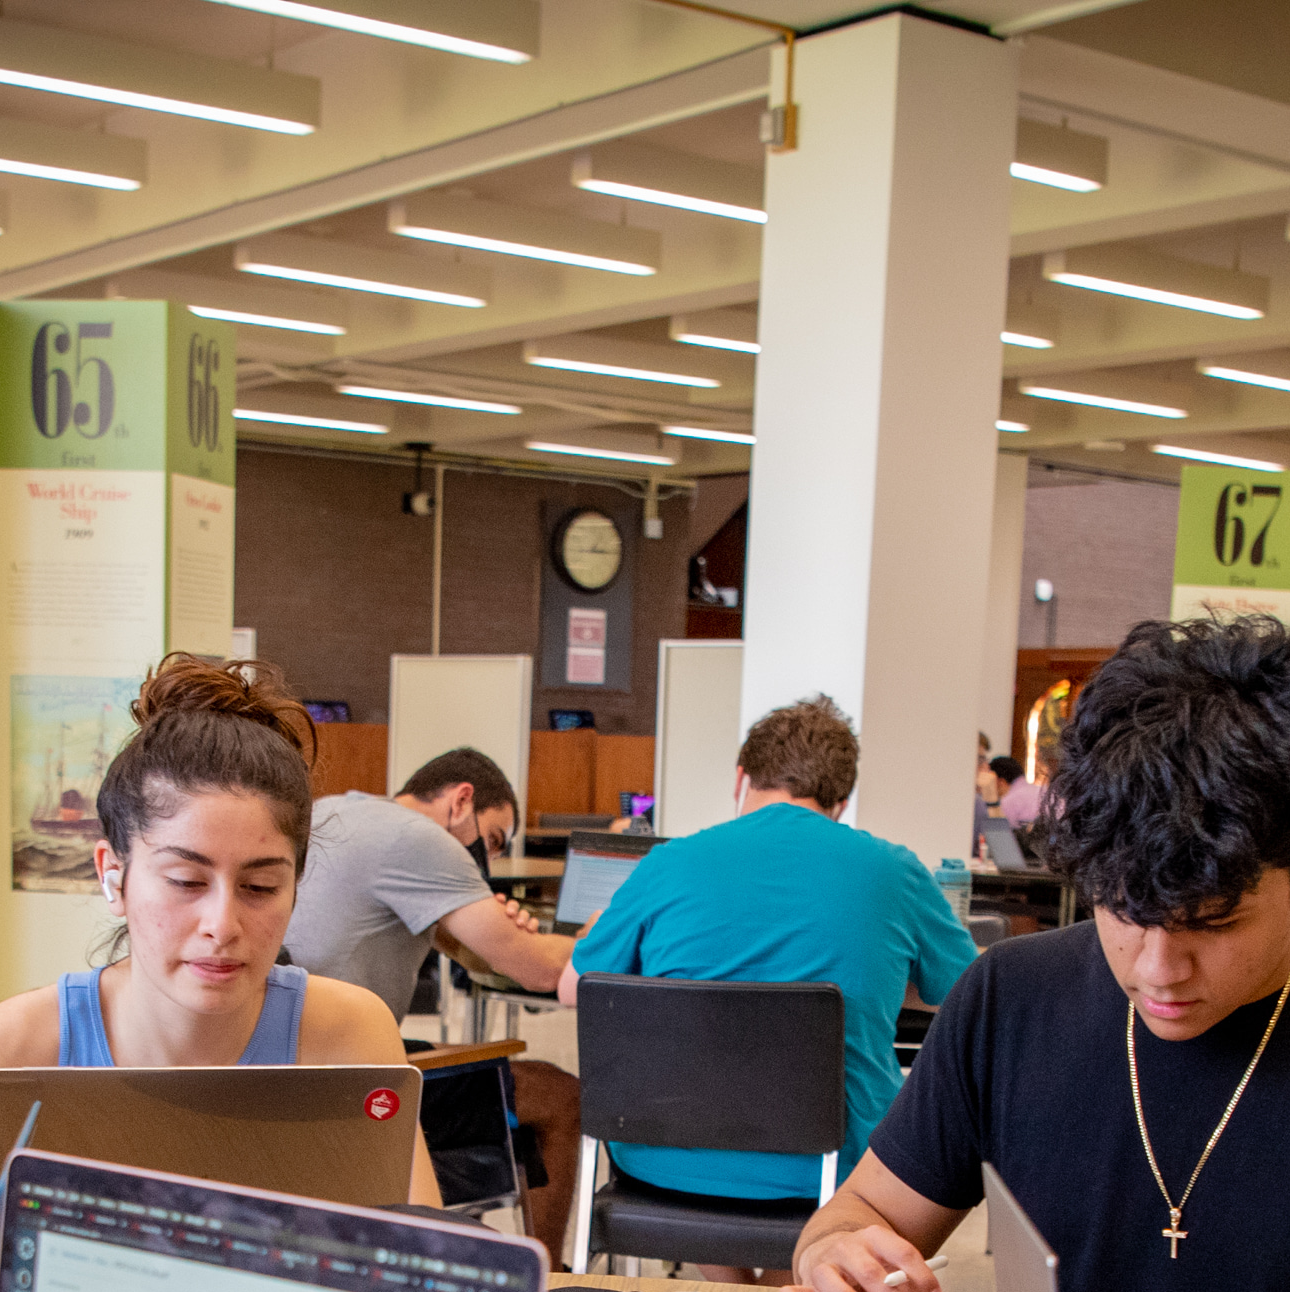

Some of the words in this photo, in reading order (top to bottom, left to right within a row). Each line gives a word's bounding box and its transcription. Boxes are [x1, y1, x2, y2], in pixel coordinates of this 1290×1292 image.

[62, 450, 96, 467] first
[27, 483, 76, 501] World
[79, 483, 132, 502] Cruise
[59, 502, 98, 525] Ship
